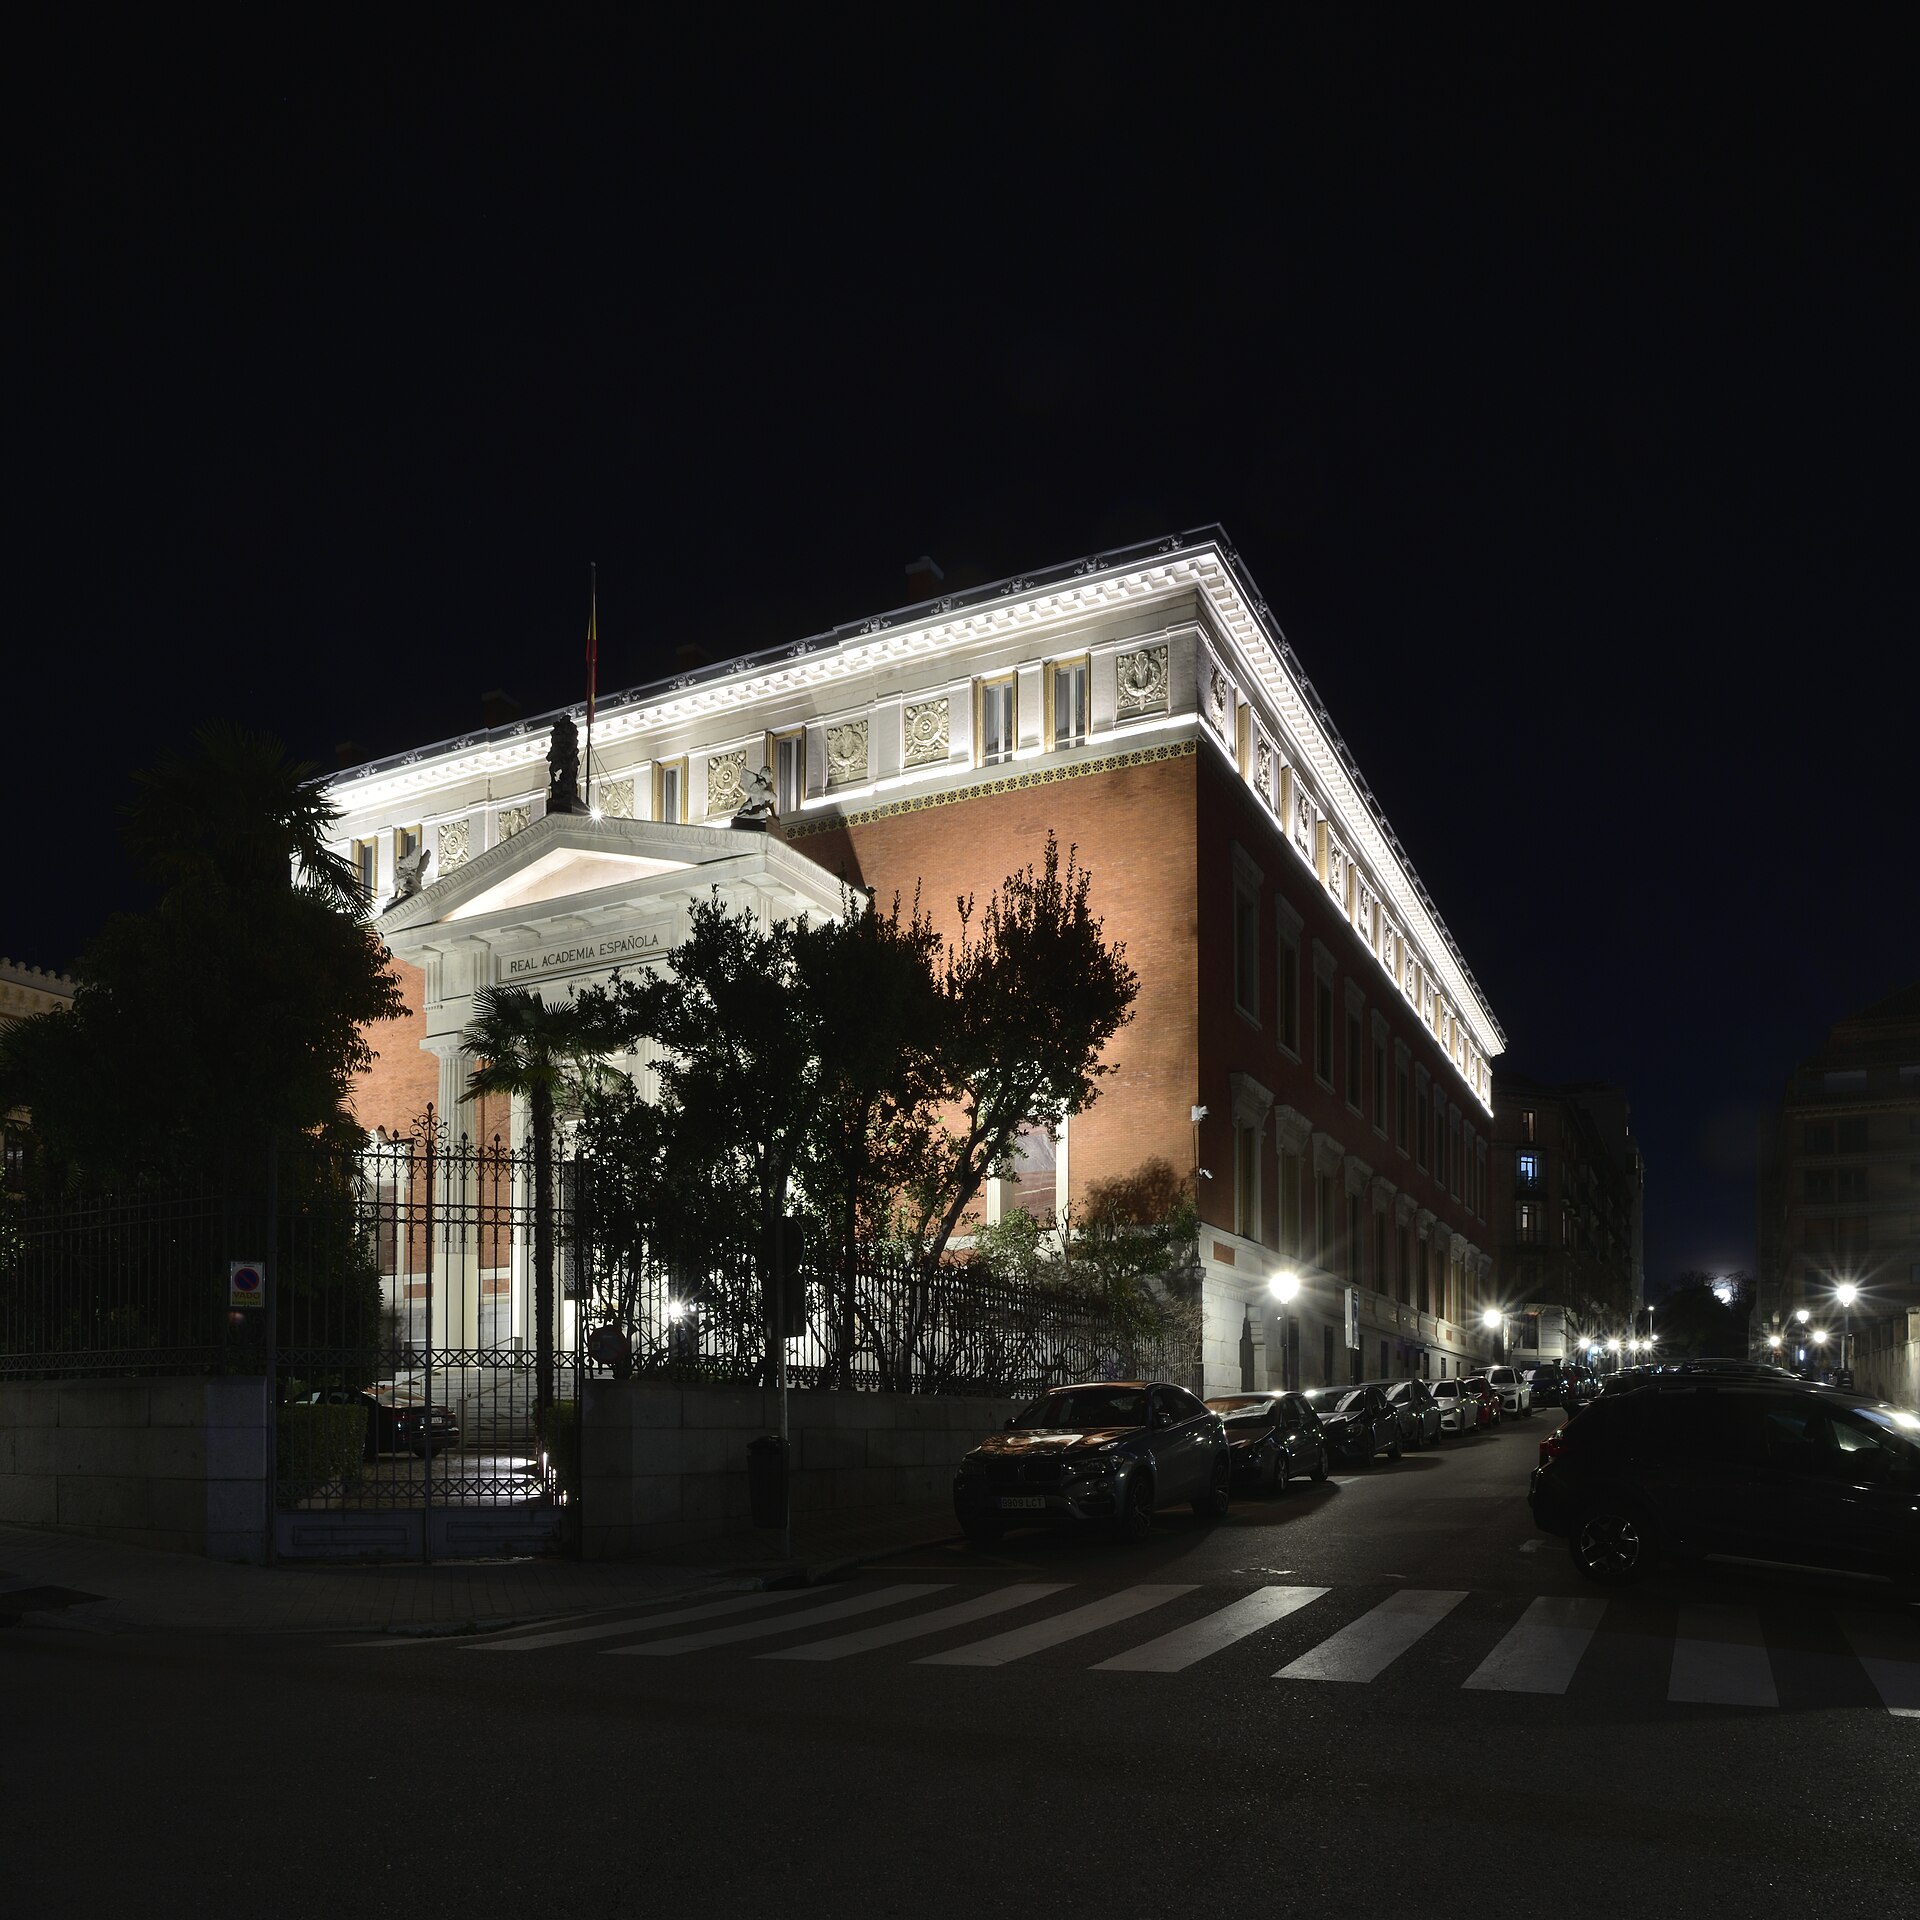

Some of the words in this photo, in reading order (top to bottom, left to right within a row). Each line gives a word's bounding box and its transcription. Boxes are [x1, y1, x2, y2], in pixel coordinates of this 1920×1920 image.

[510, 957, 538, 973] REAL
[541, 946, 595, 967] ACADEMIA
[600, 934, 659, 956] ESPAÑOLA
[232, 1291, 261, 1299] VADO
